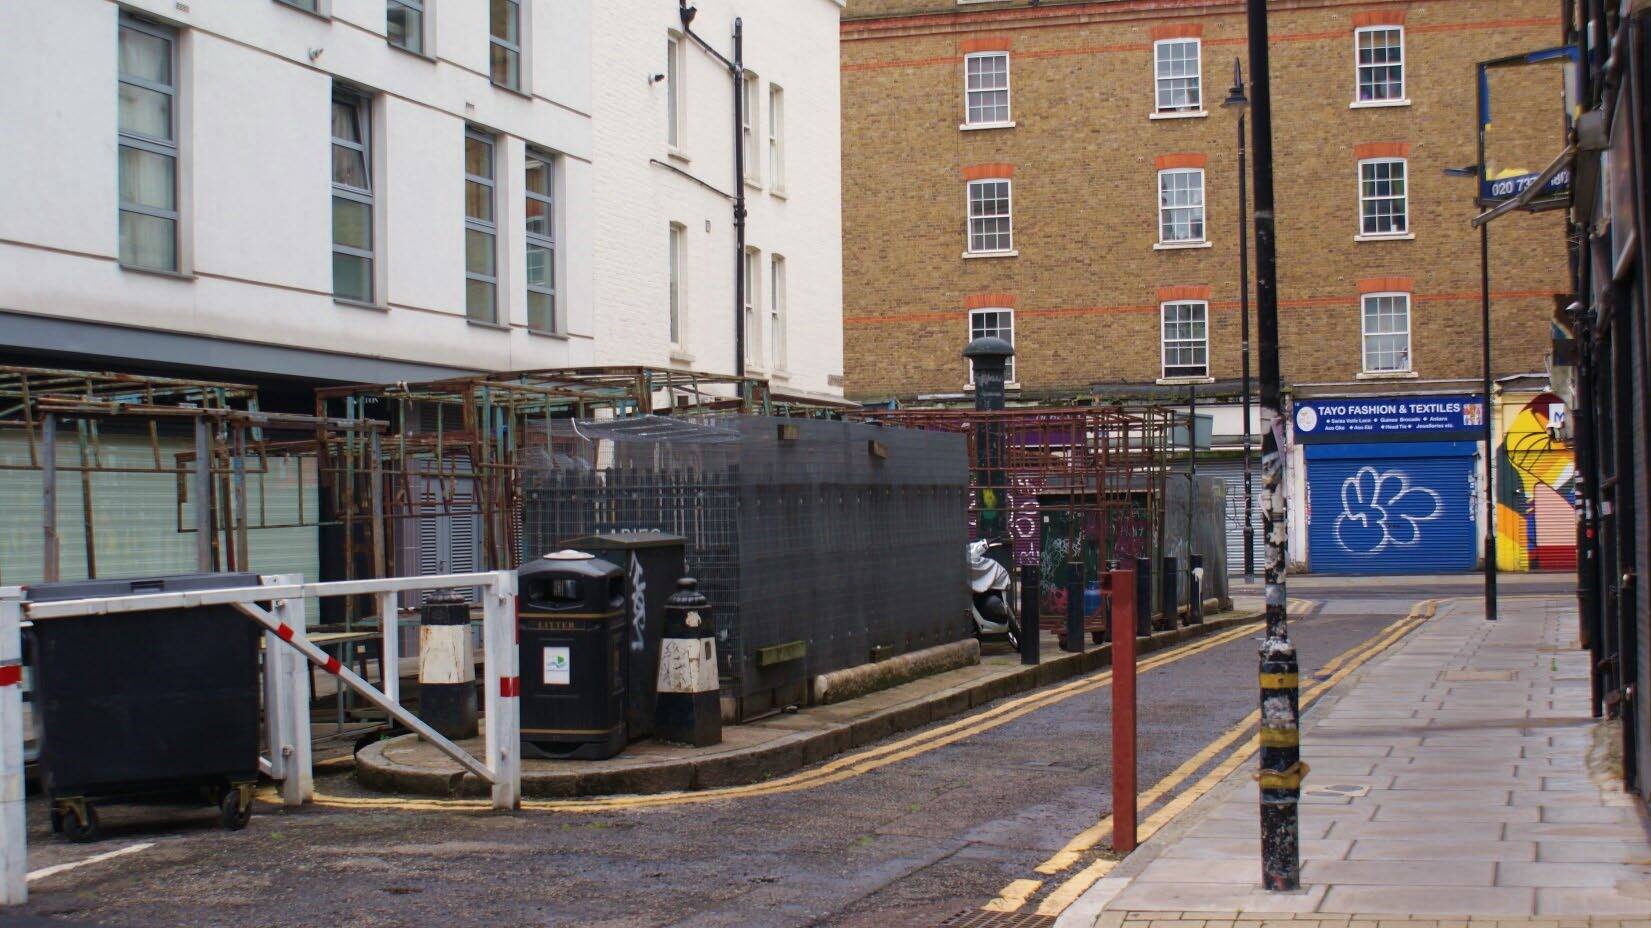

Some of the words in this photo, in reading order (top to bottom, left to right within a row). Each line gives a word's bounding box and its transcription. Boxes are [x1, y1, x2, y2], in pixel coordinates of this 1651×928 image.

[1492, 181, 1513, 196] 020
[1318, 406, 1346, 416] TAYO
[1348, 405, 1396, 415] FASHION
[1398, 404, 1407, 414] &
[1409, 403, 1461, 413] TEXTILES
[538, 621, 575, 629] LITTER
